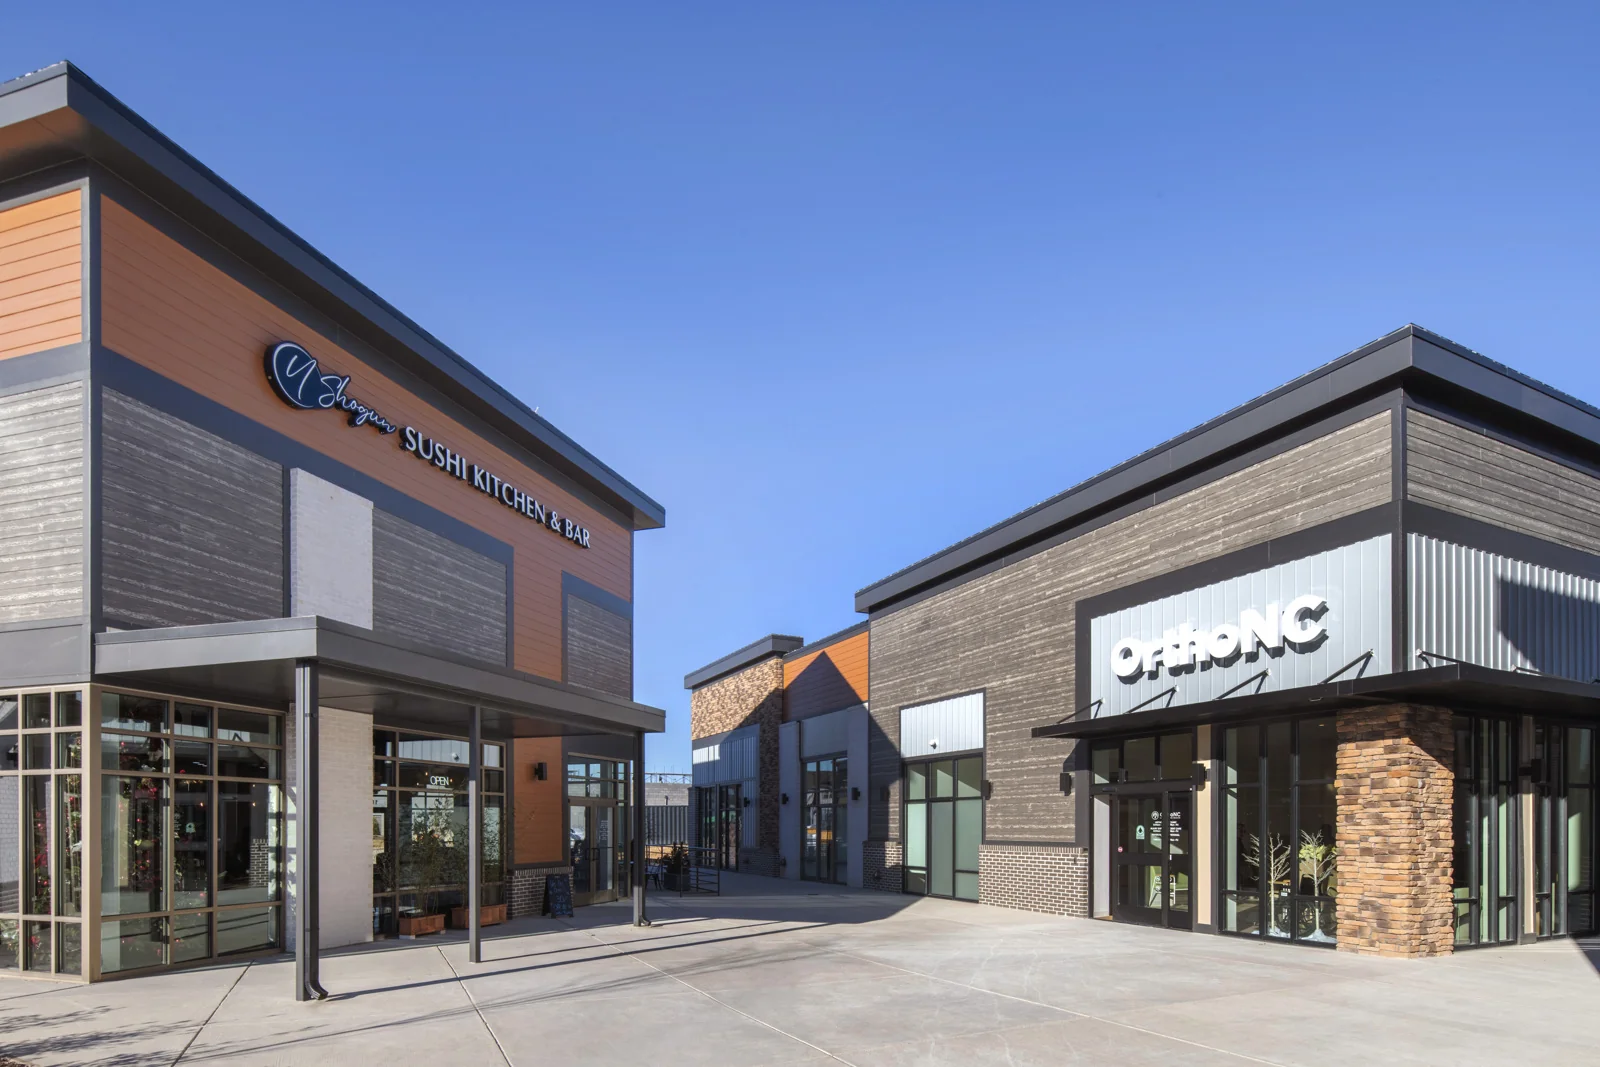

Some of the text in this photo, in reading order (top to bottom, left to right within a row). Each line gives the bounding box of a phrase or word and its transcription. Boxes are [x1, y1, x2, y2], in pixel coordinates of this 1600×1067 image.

[318, 375, 397, 433] Shogun
[405, 425, 591, 549] SUSHI KITCHEN & BAR
[1110, 594, 1328, 677] OrthoNC
[430, 775, 450, 786] OPEN
